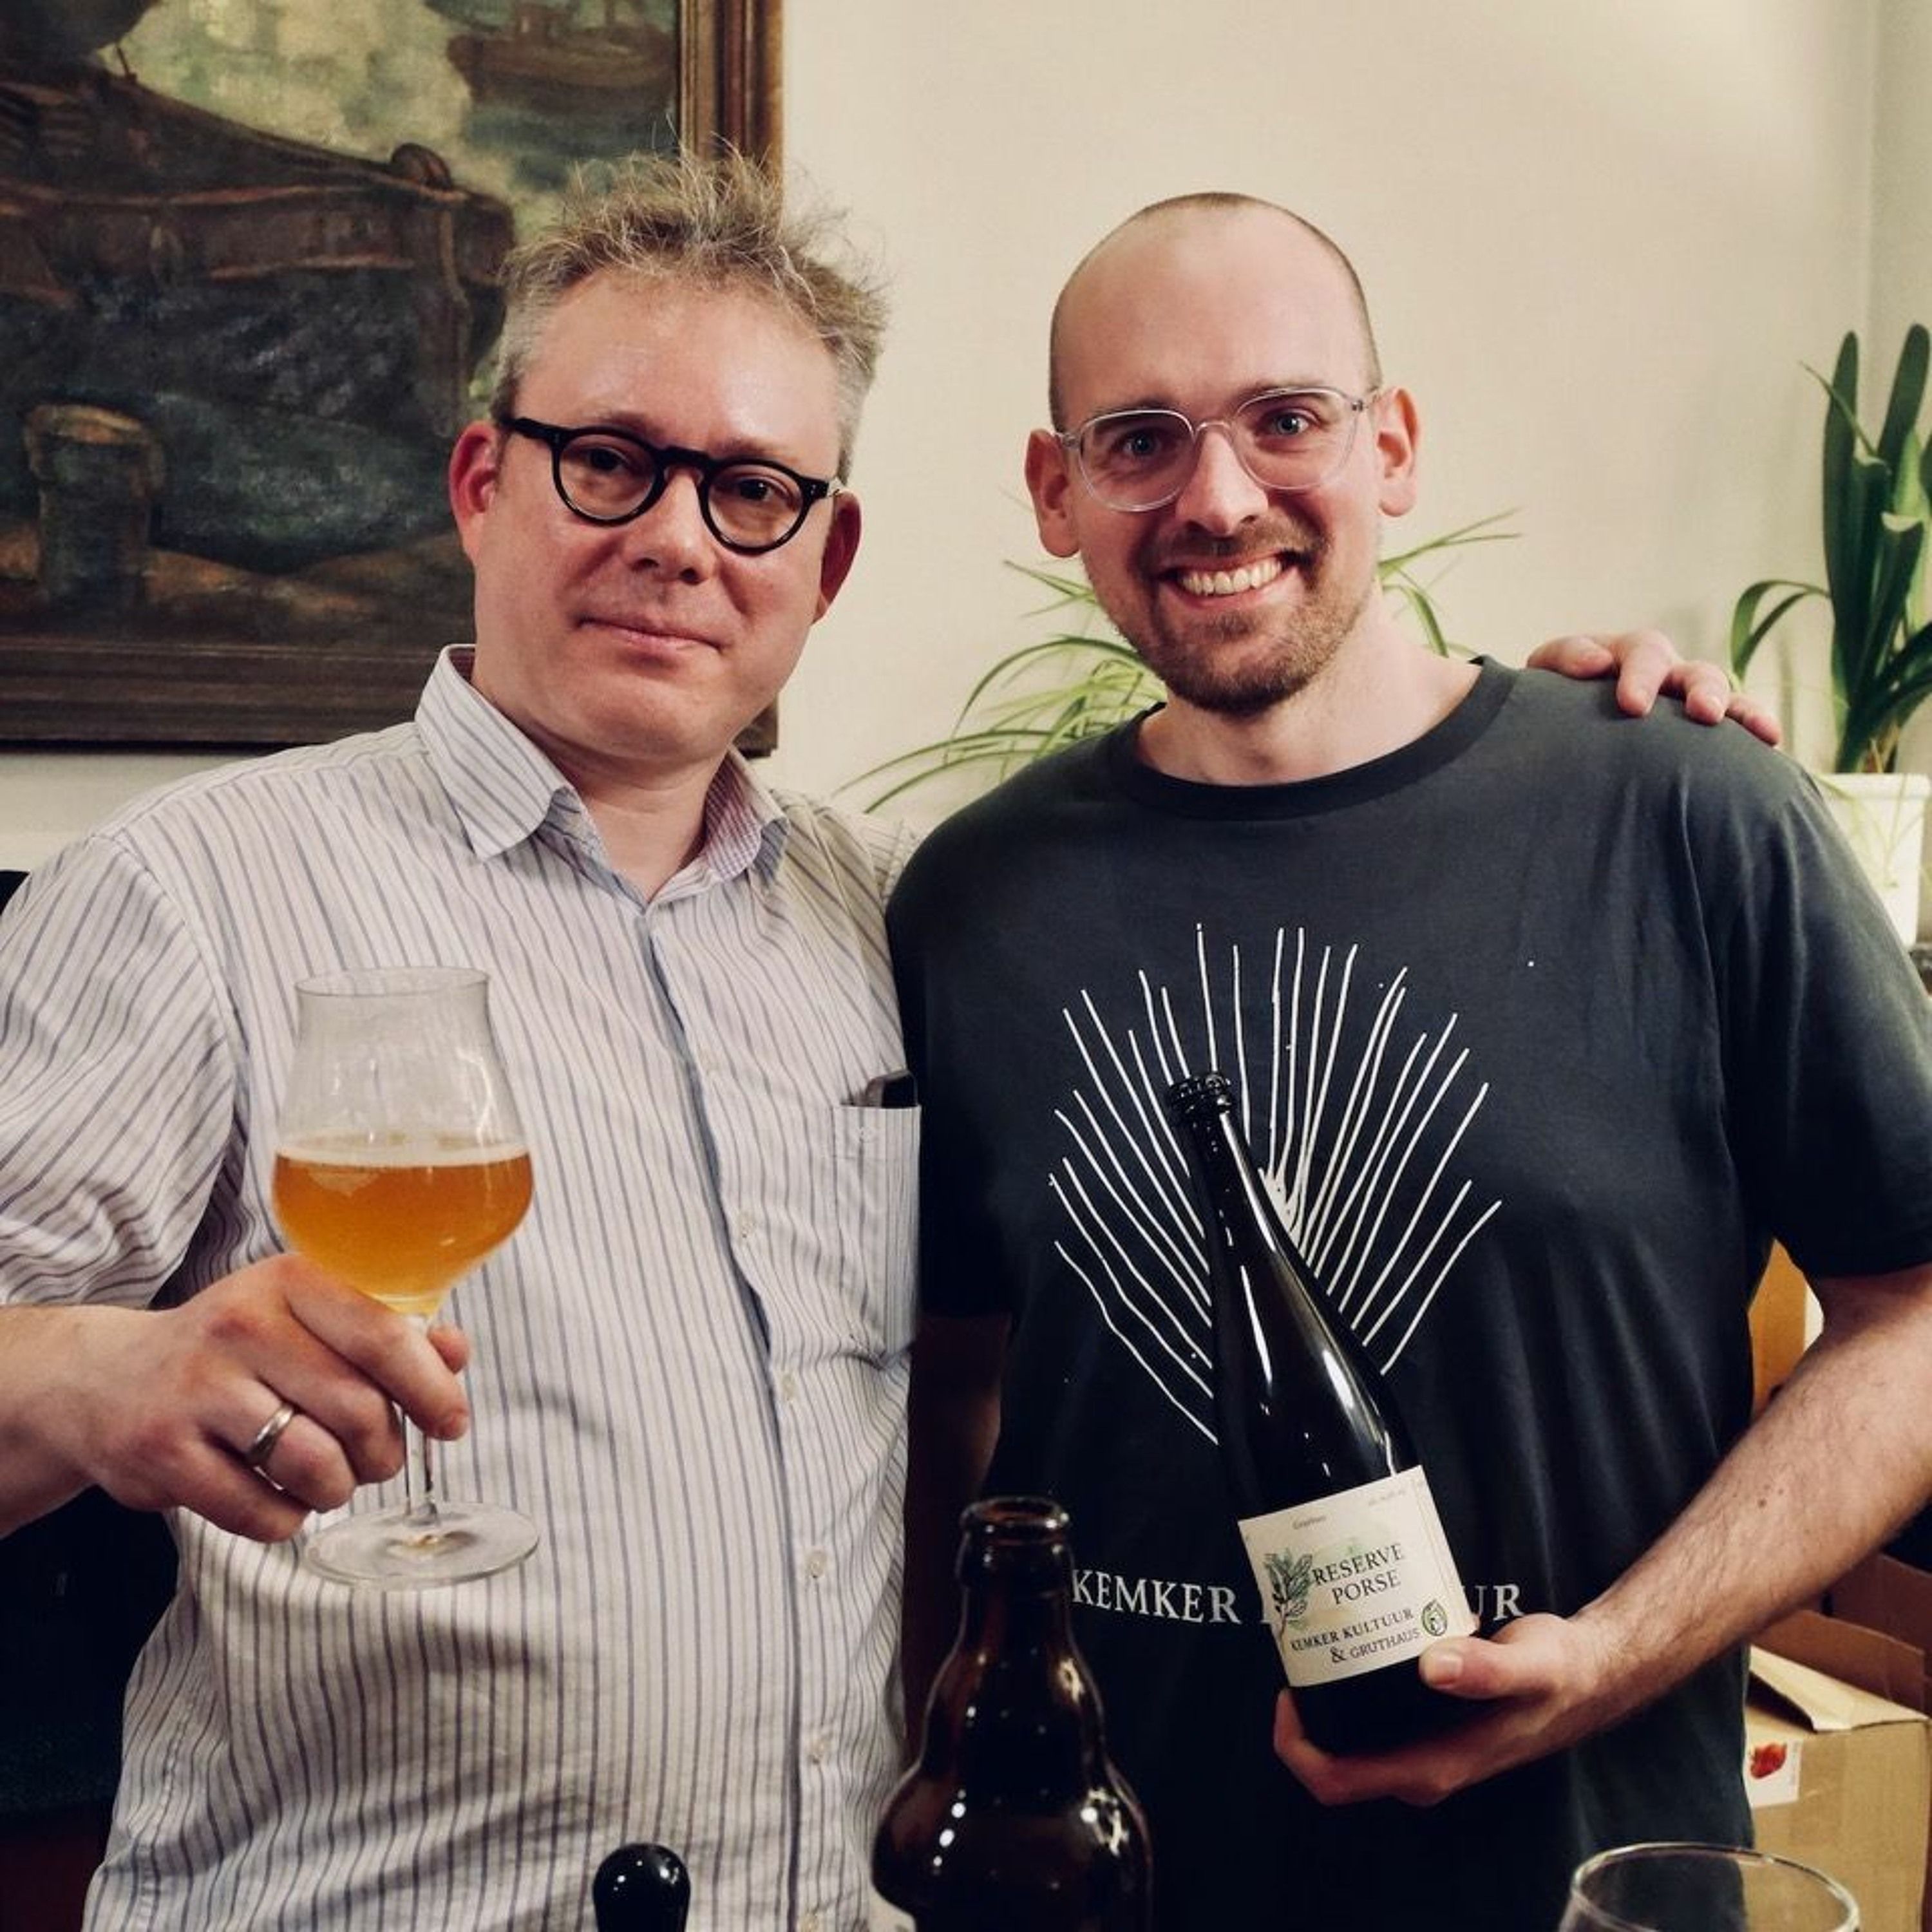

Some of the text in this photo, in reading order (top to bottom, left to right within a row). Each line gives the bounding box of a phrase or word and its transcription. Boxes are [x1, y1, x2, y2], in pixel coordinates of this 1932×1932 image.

[1312, 1543, 1403, 1586] RESERVE
[1072, 1569, 1242, 1624] KEMKER
[1332, 1569, 1401, 1604] PORSE
[1342, 1608, 1414, 1640] KULTUUR
[1330, 1627, 1421, 1663] & GRUTHAUS
